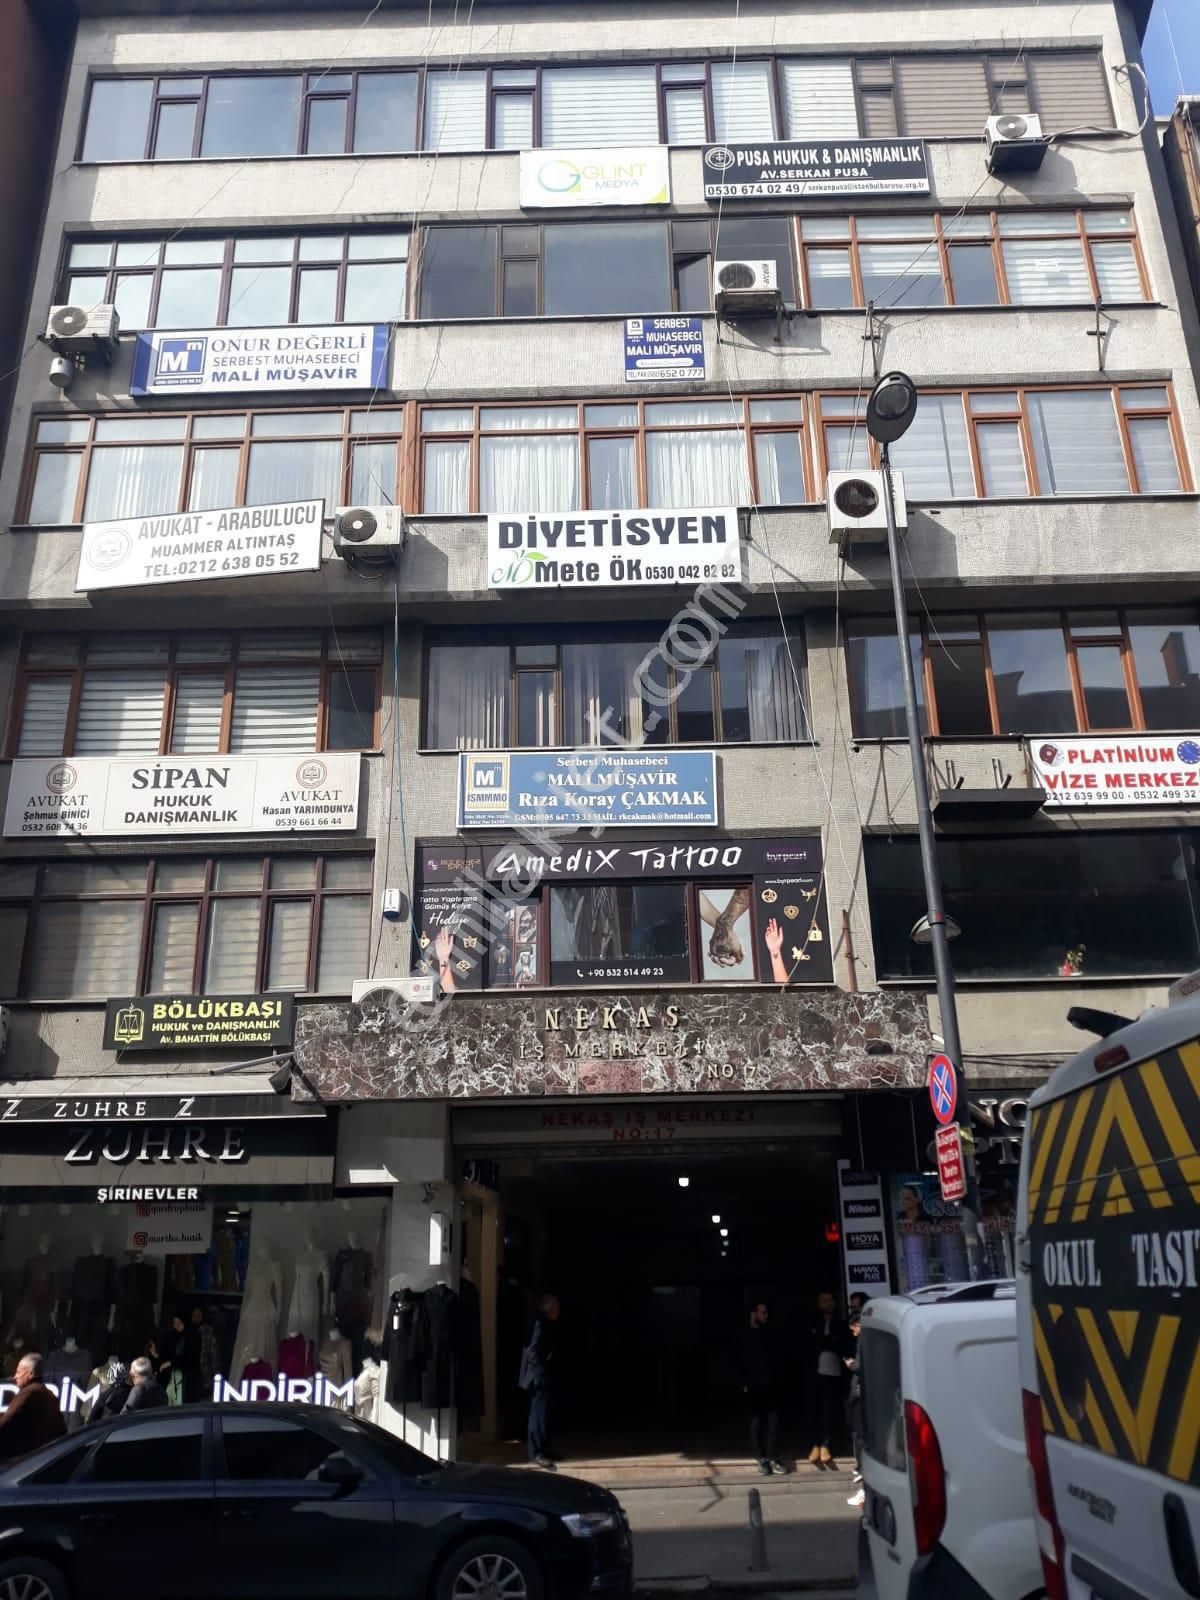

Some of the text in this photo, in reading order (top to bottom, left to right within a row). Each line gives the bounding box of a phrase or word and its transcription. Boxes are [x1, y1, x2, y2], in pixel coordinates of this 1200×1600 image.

[737, 146, 922, 167] PUSA HUKUK & DANIŞMANLIK
[582, 163, 648, 180] GLINT
[760, 167, 869, 180] AV.SERKAN PUSA
[595, 179, 640, 190] MEDYA
[707, 184, 738, 196] 0530
[741, 184, 763, 195] 674
[767, 184, 782, 194] 02
[785, 183, 800, 194] 49
[654, 318, 691, 329] SERBEST
[211, 333, 367, 352] ONUR DEĞERLİ
[213, 355, 270, 366] SERBEST
[138, 515, 202, 540] AVUKAT
[217, 505, 317, 531] ARABULUCU
[499, 513, 727, 549] DİYETİSYEN
[151, 533, 296, 558] MUAMMER ALTINTAŞ
[221, 555, 251, 570] 638
[255, 554, 275, 568] 05
[279, 552, 300, 566] 52
[535, 555, 736, 582] Mete ÖK 0530 042 82 82
[556, 756, 669, 767] Serbest Muhasebeci
[131, 764, 230, 789] SİPAN
[1104, 772, 1200, 788] MERKEZ
[27, 795, 88, 807] AVUKAT
[154, 795, 211, 807] HUKUK
[280, 790, 342, 802] AVUKAT
[565, 791, 616, 810] Koray
[620, 791, 708, 810] ÇAKMAK
[1074, 791, 1093, 800] 639
[1096, 791, 1109, 799] 99
[1112, 791, 1124, 799] 00
[1133, 791, 1159, 799] 0532
[1162, 790, 1181, 798] 499
[1184, 790, 1197, 798] 32
[23, 811, 58, 821] Şehmus
[262, 806, 291, 815] Hasan
[555, 813, 570, 822] 647
[571, 813, 582, 822] 73
[124, 810, 238, 826] DANIŞMANLIK
[275, 818, 297, 826] 0539
[299, 818, 315, 826] 661
[331, 817, 342, 825] 44
[22, 823, 43, 831] 0532
[77, 822, 88, 830] 36
[623, 968, 639, 976] 514
[152, 1000, 282, 1019] BÖLÜKBAŞI
[545, 1005, 680, 1030] NEKAŞ
[152, 1022, 188, 1032] HUKUK
[206, 1020, 280, 1031] DANIŞMANLIK
[707, 1064, 735, 1079] NO
[541, 1111, 614, 1128] NEKAŞ
[613, 1127, 677, 1141] NO:17
[1043, 1239, 1101, 1287] OKUL
[213, 1372, 354, 1407] İNDİRİM
